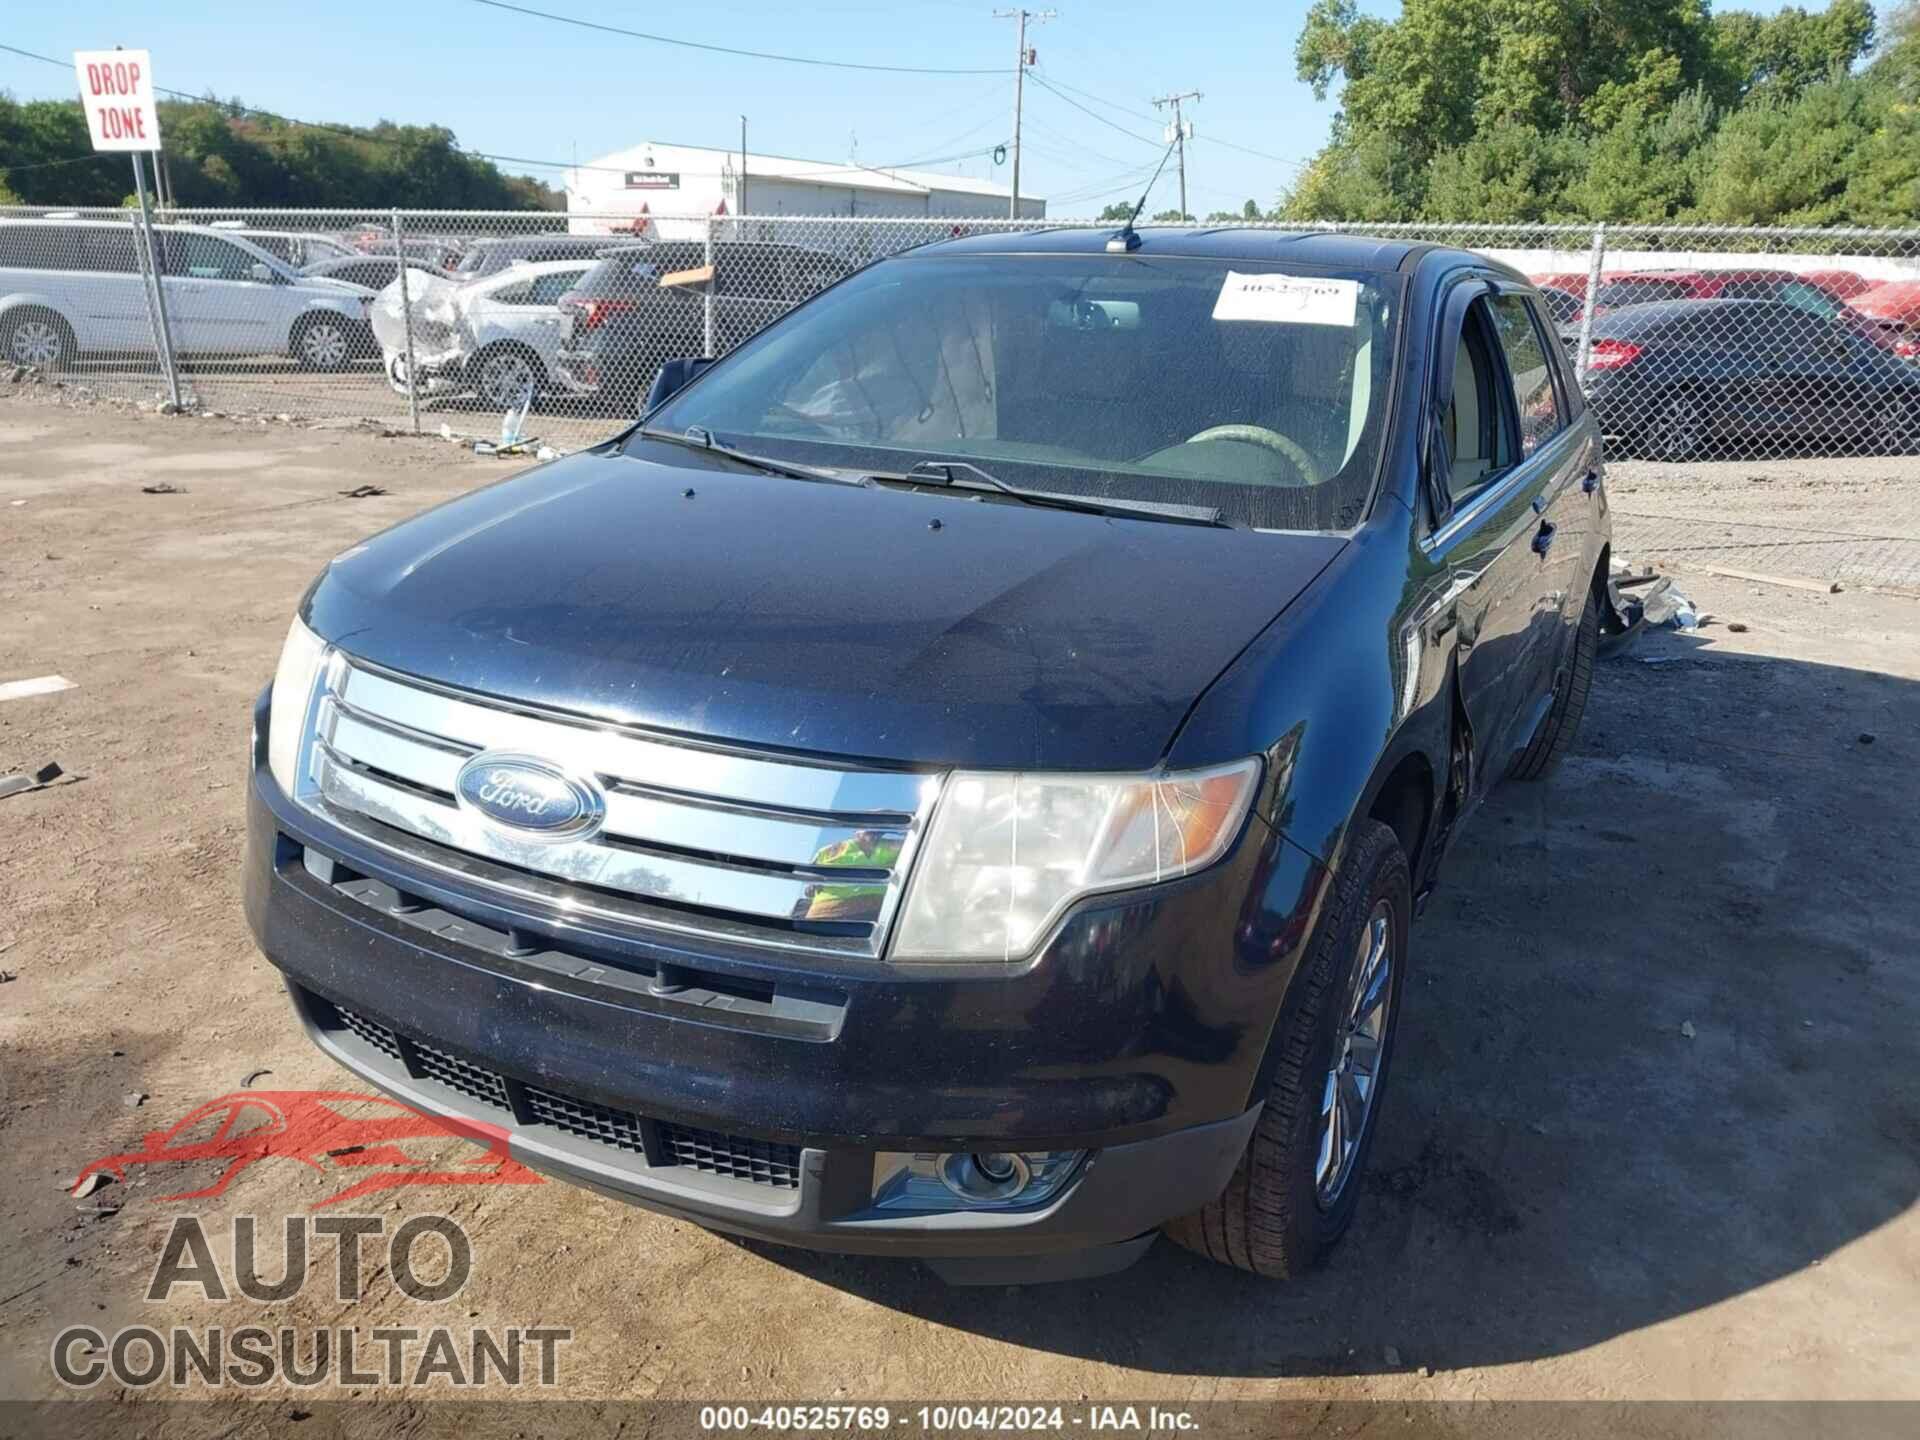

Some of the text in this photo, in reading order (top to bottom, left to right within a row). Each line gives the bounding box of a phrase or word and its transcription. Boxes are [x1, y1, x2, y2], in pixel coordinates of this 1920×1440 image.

[87, 62, 140, 96] DROP
[98, 107, 146, 139] ZONE
[479, 768, 550, 816] Ford
